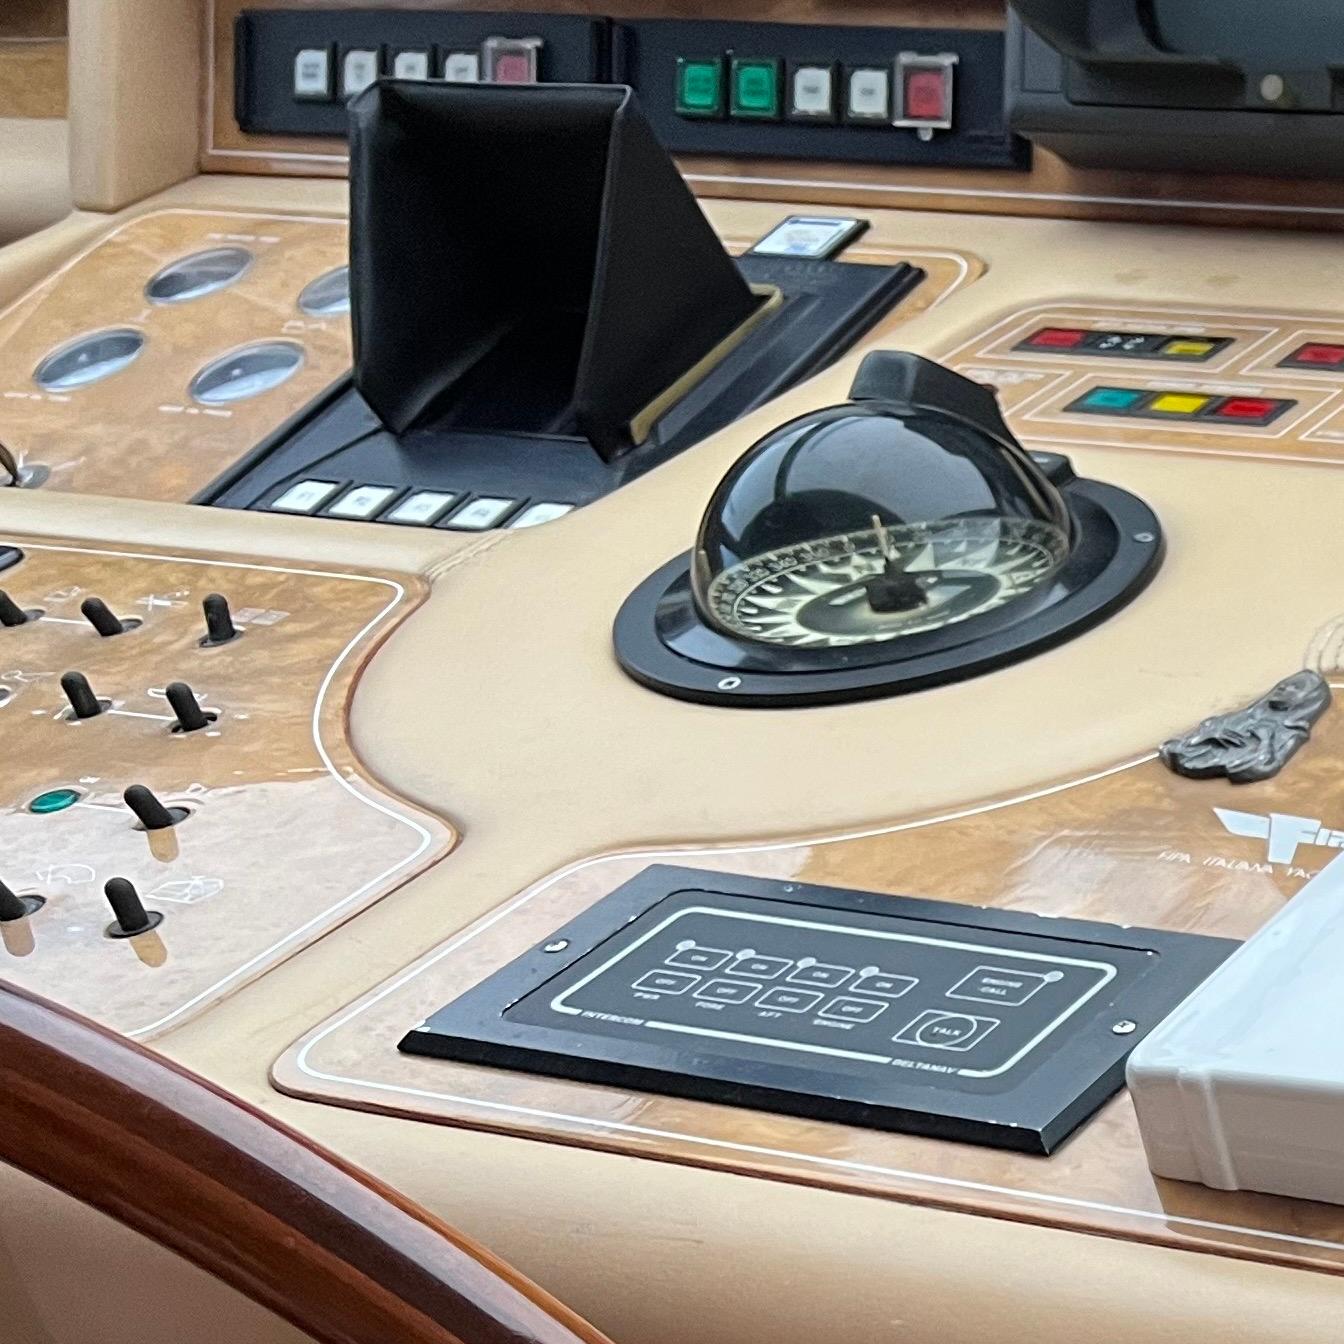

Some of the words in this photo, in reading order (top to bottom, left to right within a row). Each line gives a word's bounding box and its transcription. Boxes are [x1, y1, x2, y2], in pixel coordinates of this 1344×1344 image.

[581, 1010, 645, 1026] INTERCOM
[931, 1026, 963, 1037] TALK
[892, 1058, 958, 1075] DELTANAV
